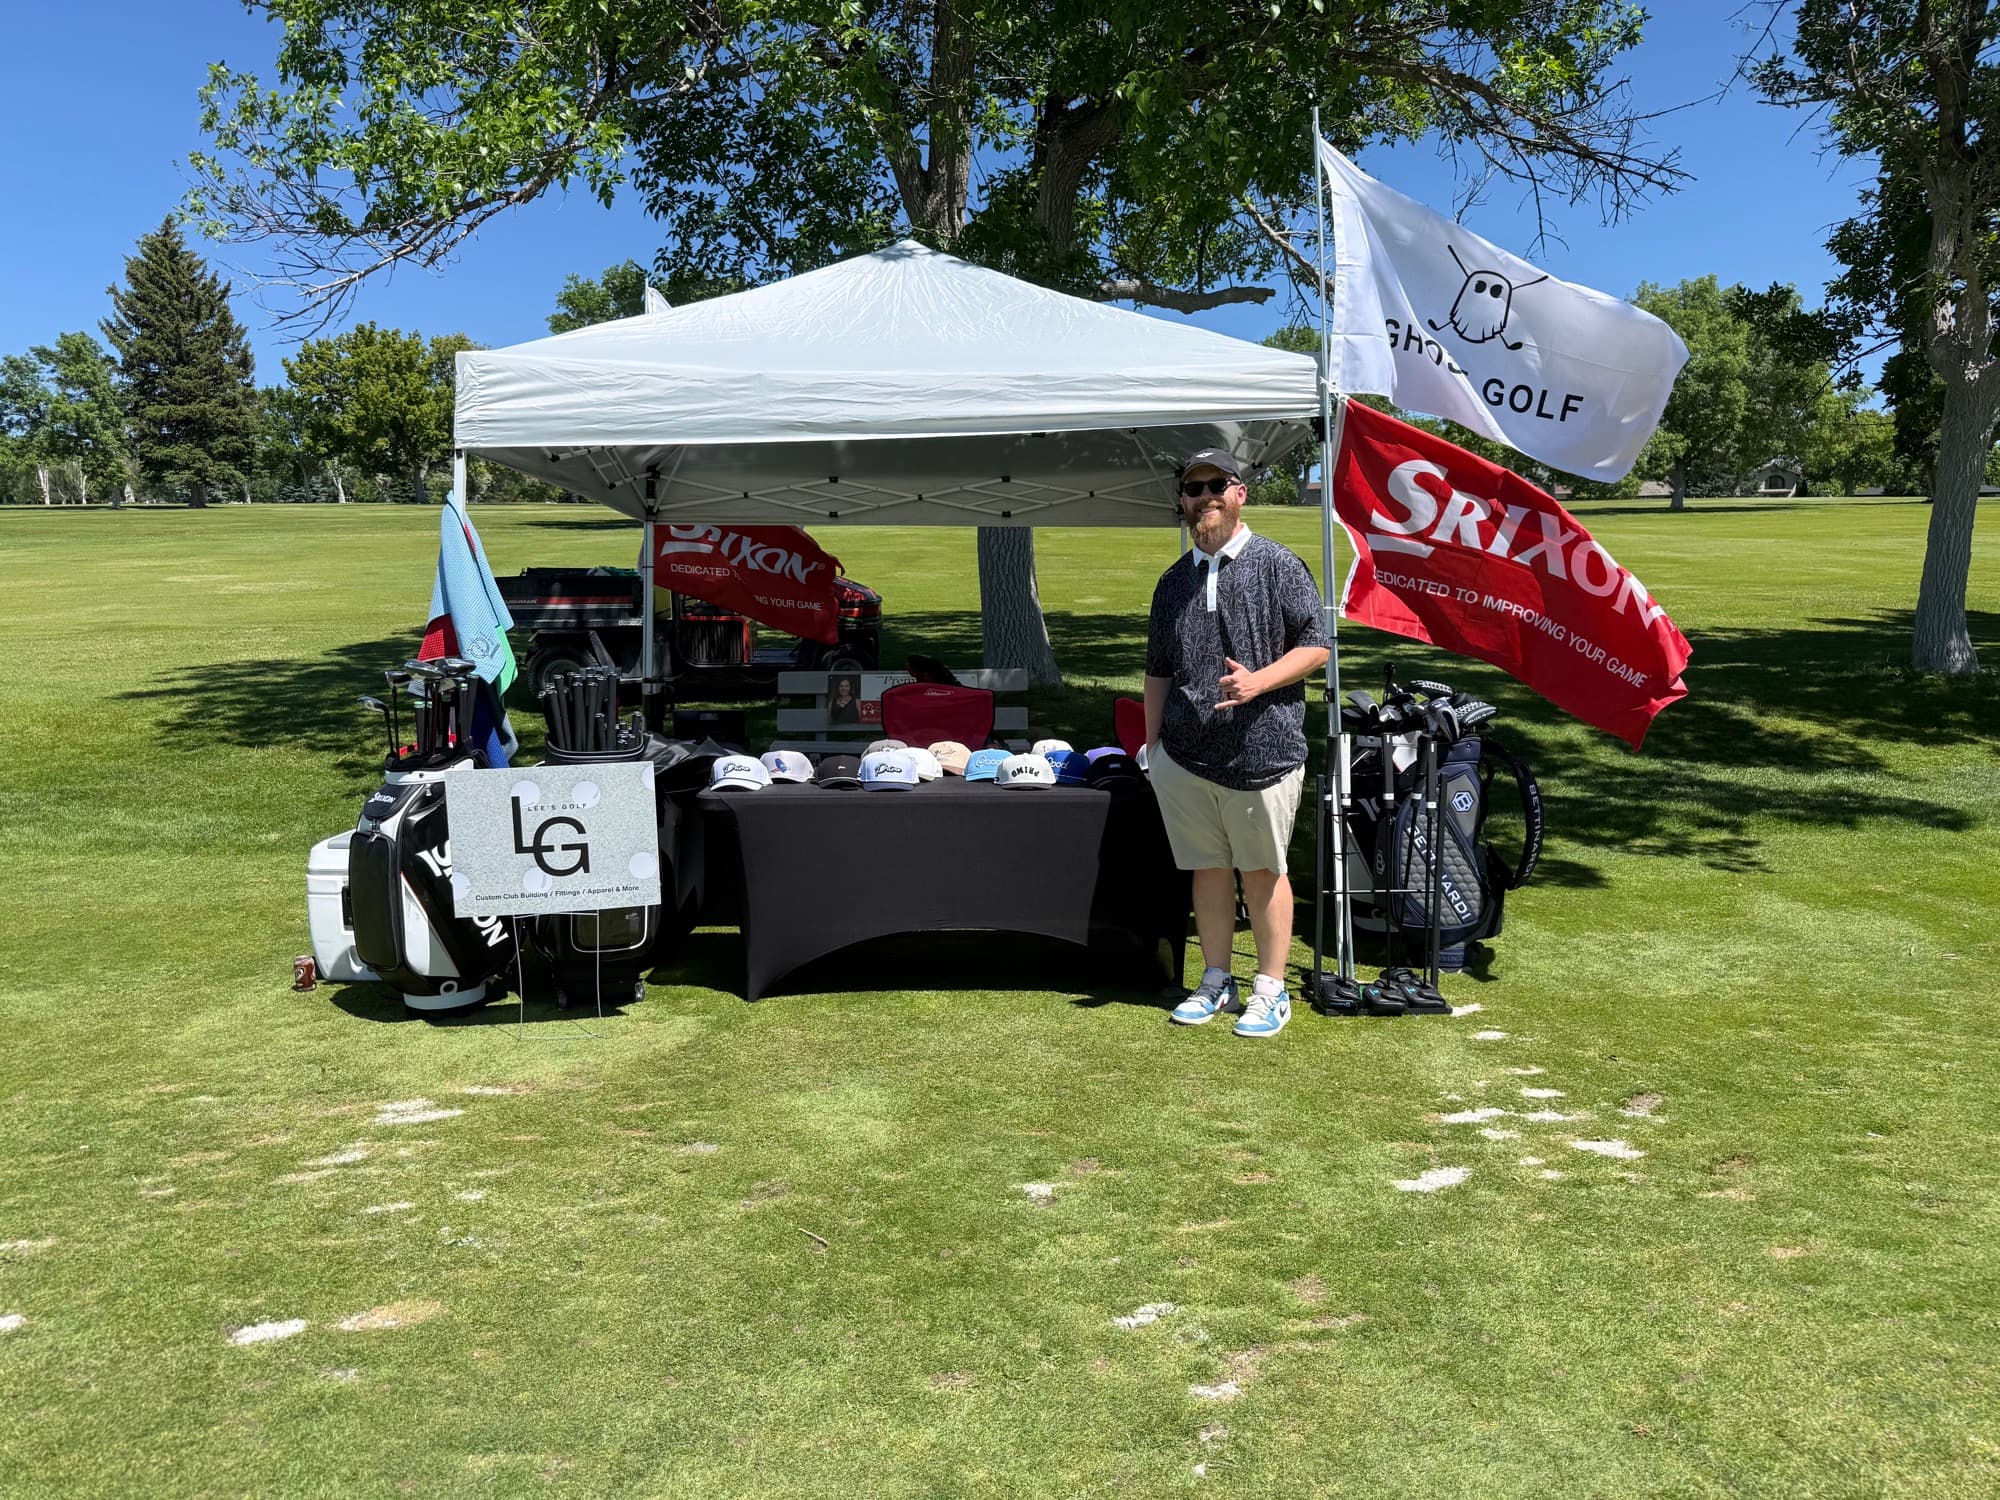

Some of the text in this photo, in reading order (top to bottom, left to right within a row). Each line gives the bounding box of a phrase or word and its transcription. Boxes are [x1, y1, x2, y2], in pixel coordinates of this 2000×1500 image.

[1482, 378, 1584, 422] GOLF
[1369, 459, 1667, 630] SRIXON
[670, 563, 730, 577] DEDICATED
[769, 597, 795, 609] YOUR
[797, 600, 822, 611] GAME
[1374, 569, 1648, 689] EDICATED TO IMPROVING YOUR GAME
[527, 803, 557, 812] LEE'S
[511, 796, 590, 877] LG
[503, 892, 519, 900] Club
[520, 891, 549, 899] Building
[587, 886, 614, 895] Apparel
